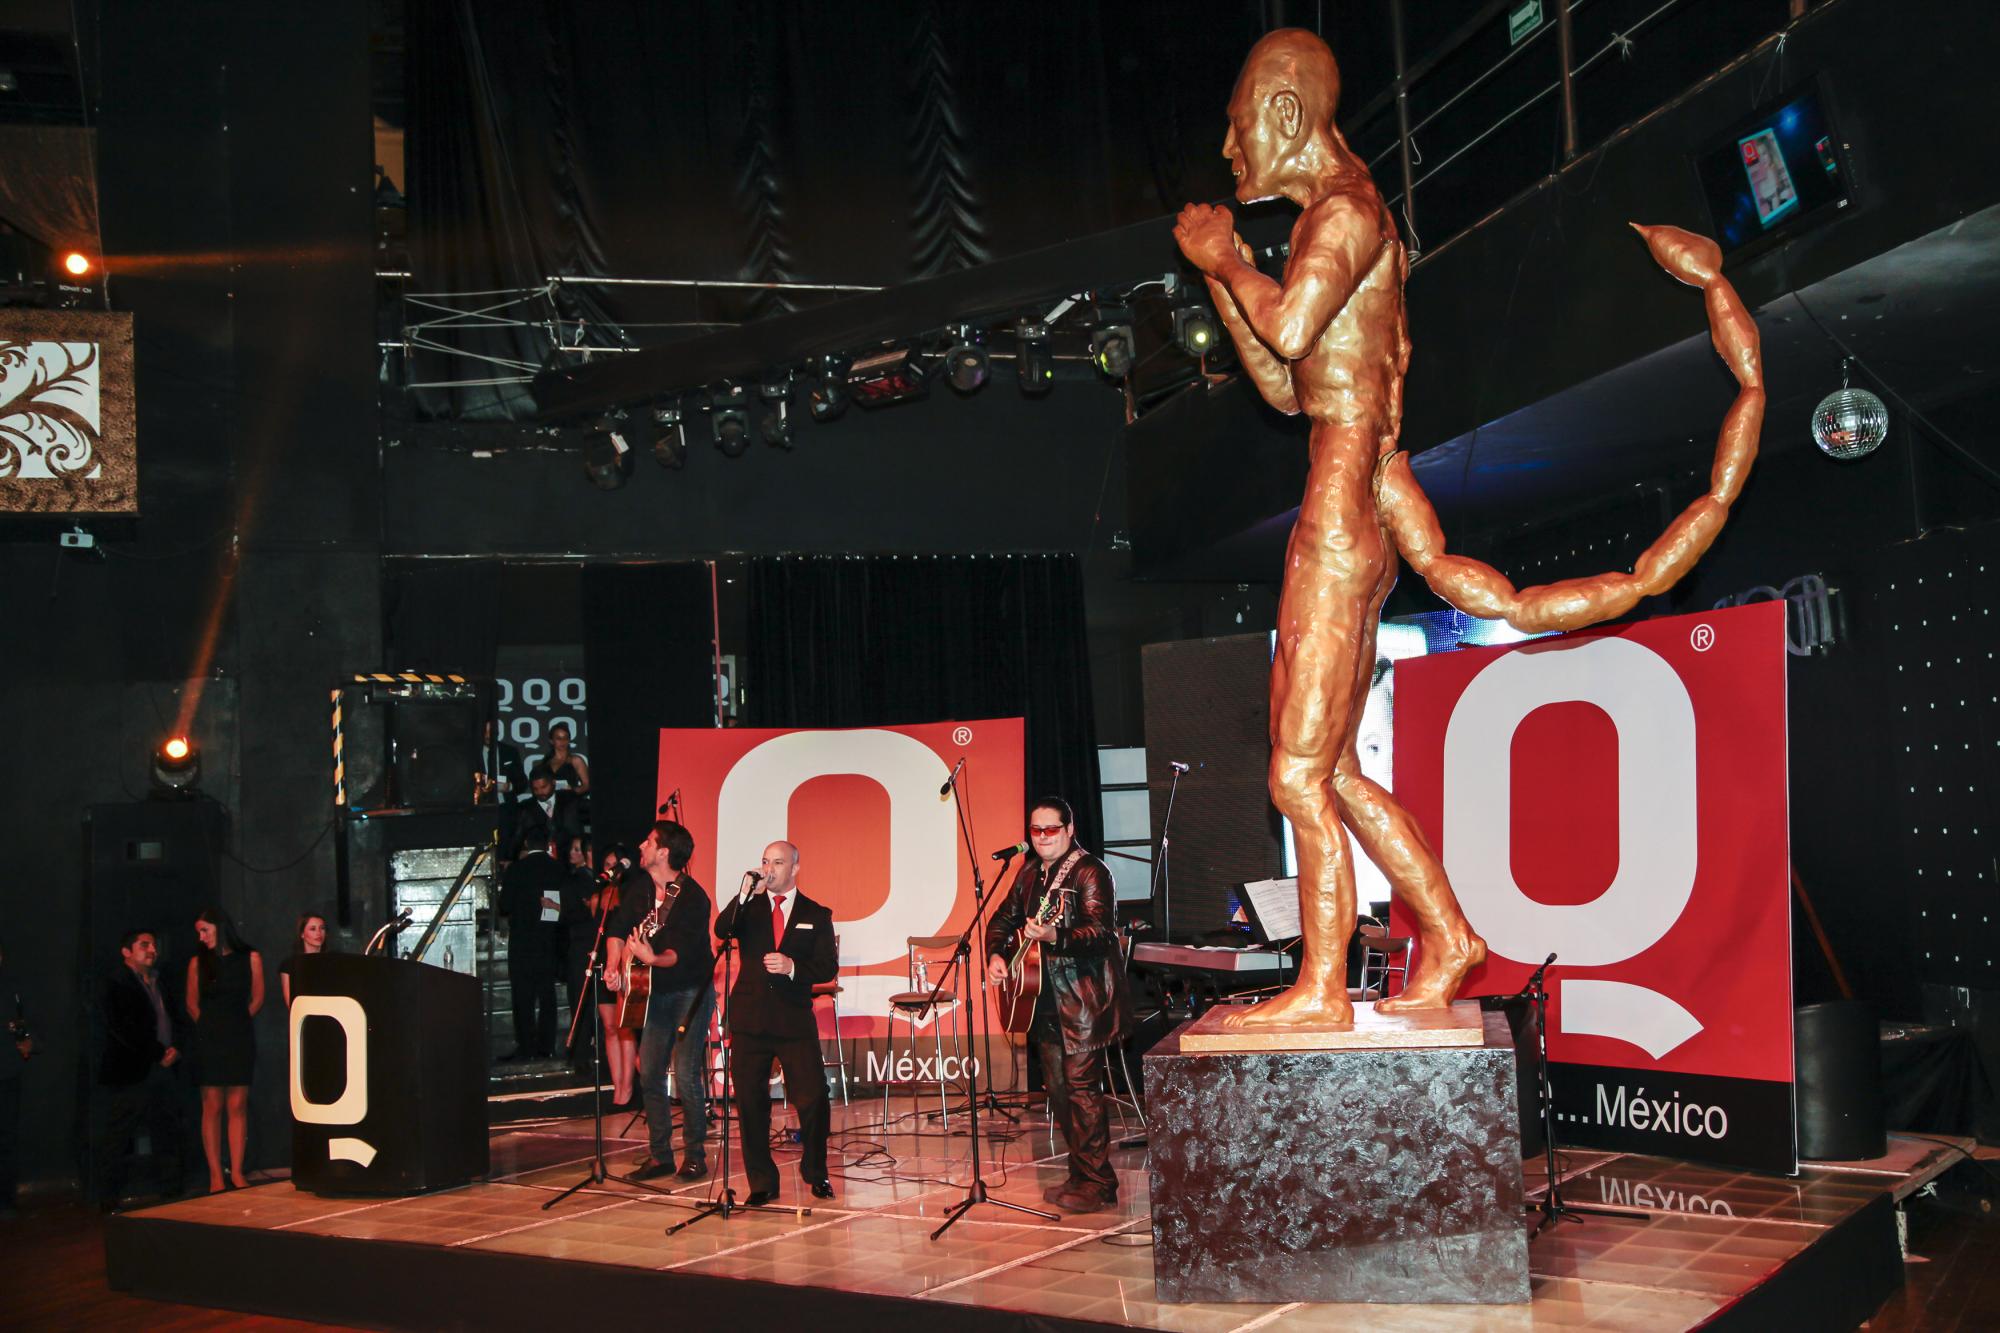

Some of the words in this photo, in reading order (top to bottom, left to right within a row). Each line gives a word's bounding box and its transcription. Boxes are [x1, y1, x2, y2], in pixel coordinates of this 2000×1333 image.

[511, 716, 540, 749] Q
[523, 678, 551, 712] Q
[559, 677, 587, 711] Q
[715, 728, 961, 1030] Q
[1443, 636, 1704, 1060] Q
[289, 995, 378, 1169] Q
